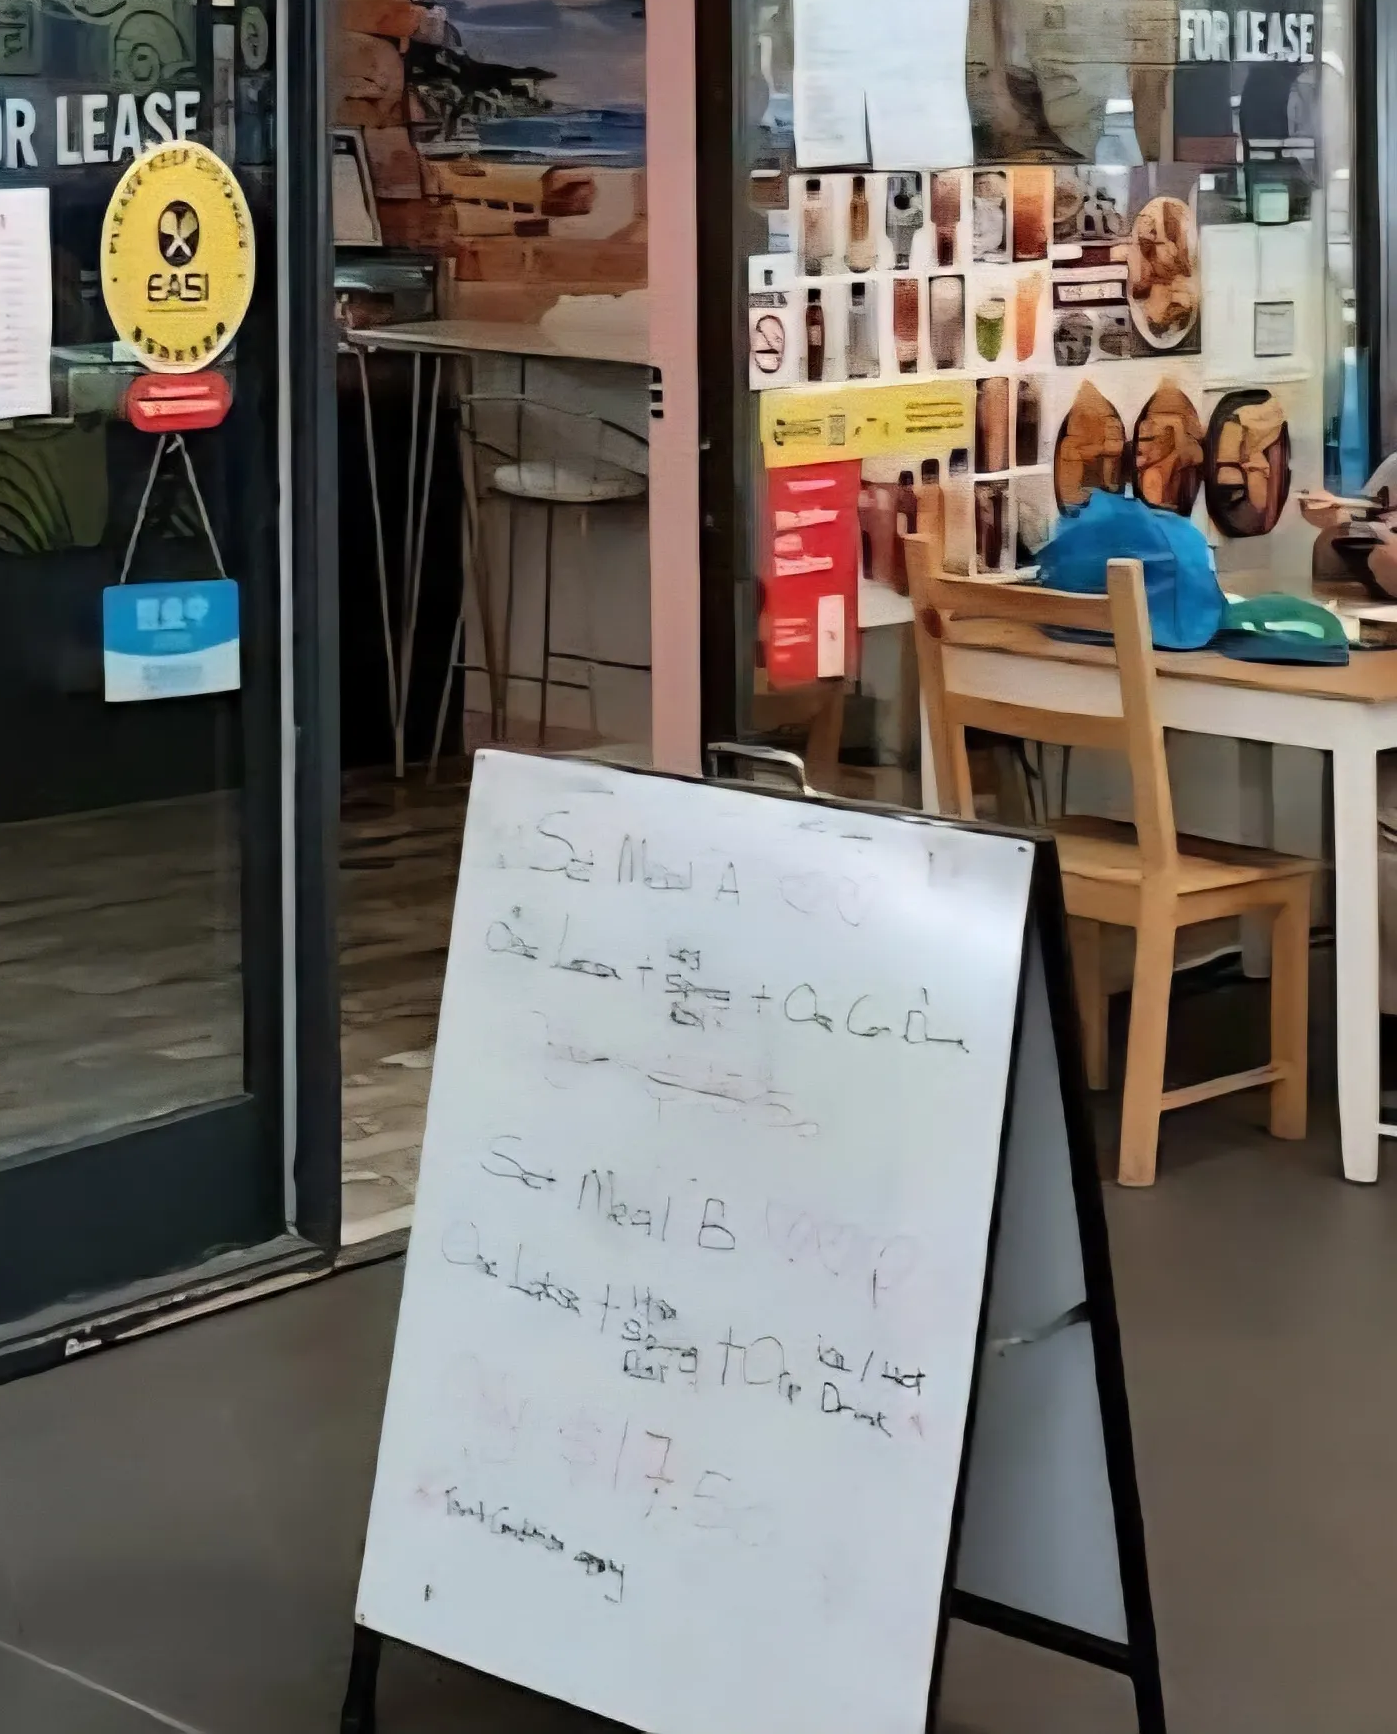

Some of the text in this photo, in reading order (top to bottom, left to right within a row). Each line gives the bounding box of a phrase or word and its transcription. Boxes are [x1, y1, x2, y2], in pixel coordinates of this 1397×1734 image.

[1179, 9, 1315, 63] FOR LEASE
[57, 91, 201, 165] LEASE
[148, 273, 209, 302] EASI
